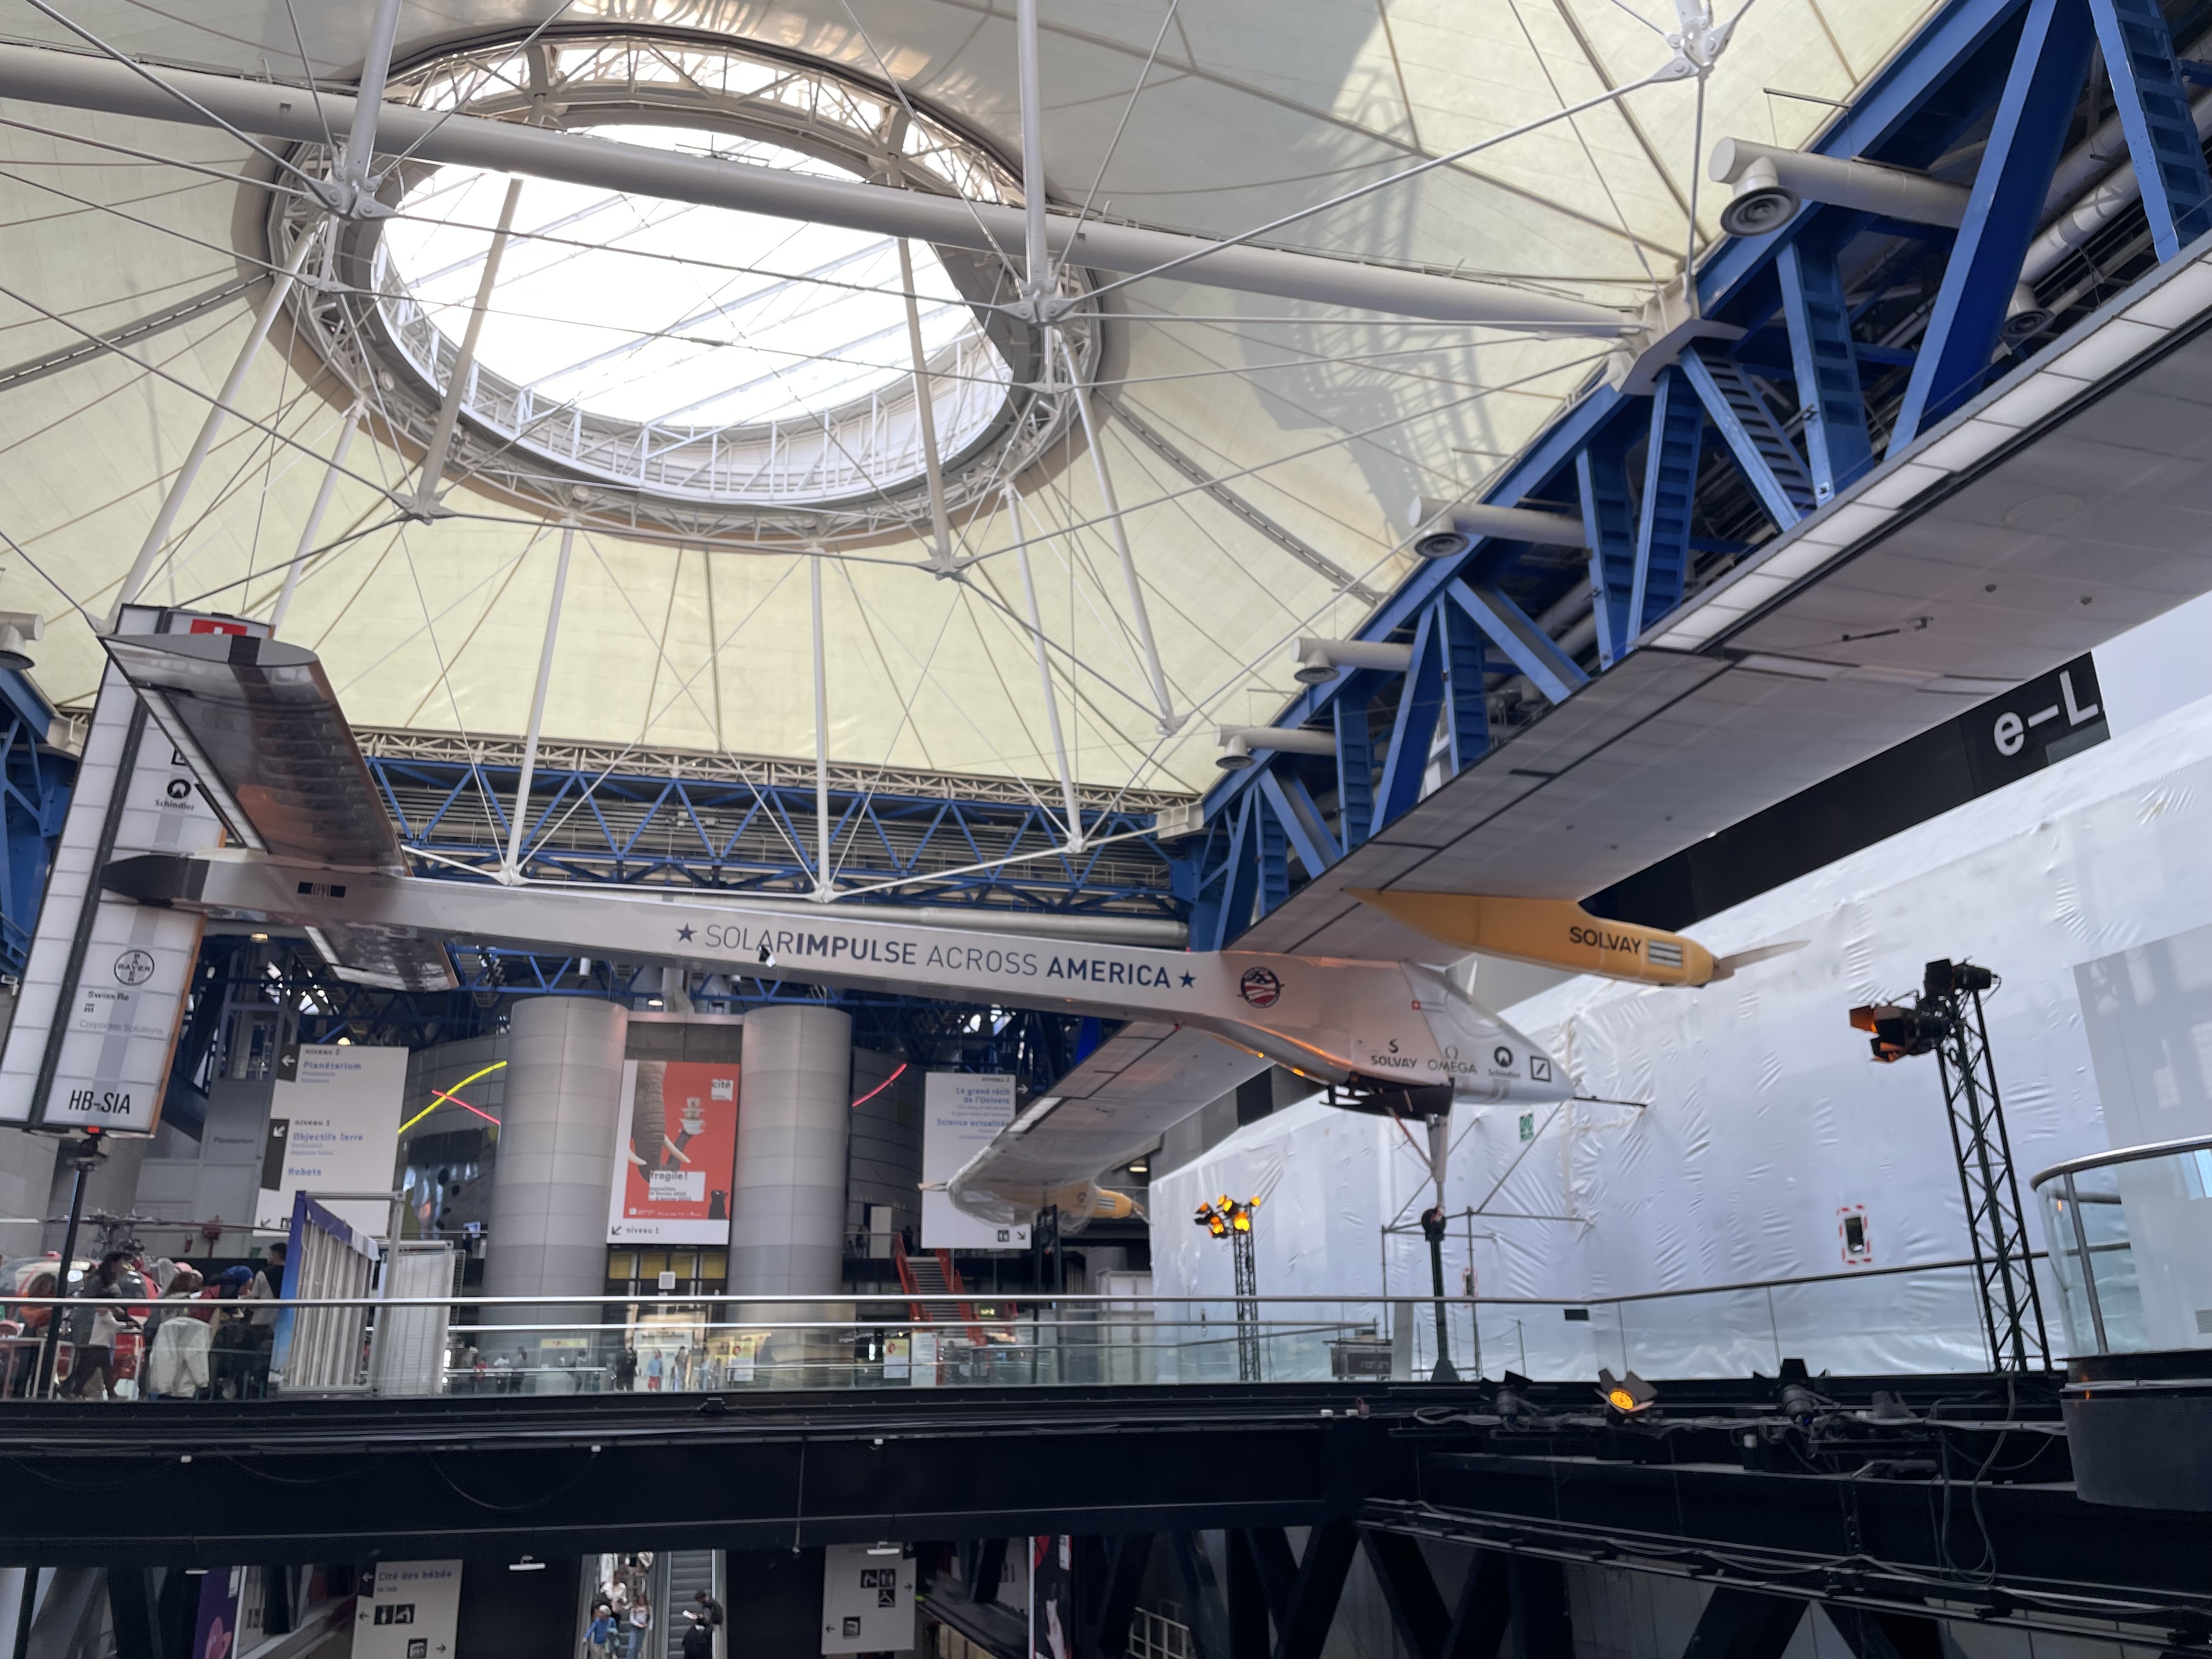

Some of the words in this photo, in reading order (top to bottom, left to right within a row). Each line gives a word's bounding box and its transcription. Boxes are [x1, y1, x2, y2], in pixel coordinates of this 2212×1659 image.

[155, 798, 194, 810] Schindler
[1570, 926, 1641, 955] SOLVAY
[927, 945, 1037, 976] ACROSS
[1047, 956, 1171, 988] AMERICA
[1371, 1054, 1417, 1069] SOLVAY
[1427, 1058, 1477, 1075] OMEGA
[1487, 1069, 1521, 1078] Schindler
[968, 1087, 990, 1096] grand
[992, 1087, 1010, 1096] récit
[69, 1090, 131, 1114] HB-SIA
[626, 1226, 653, 1234] niveau
